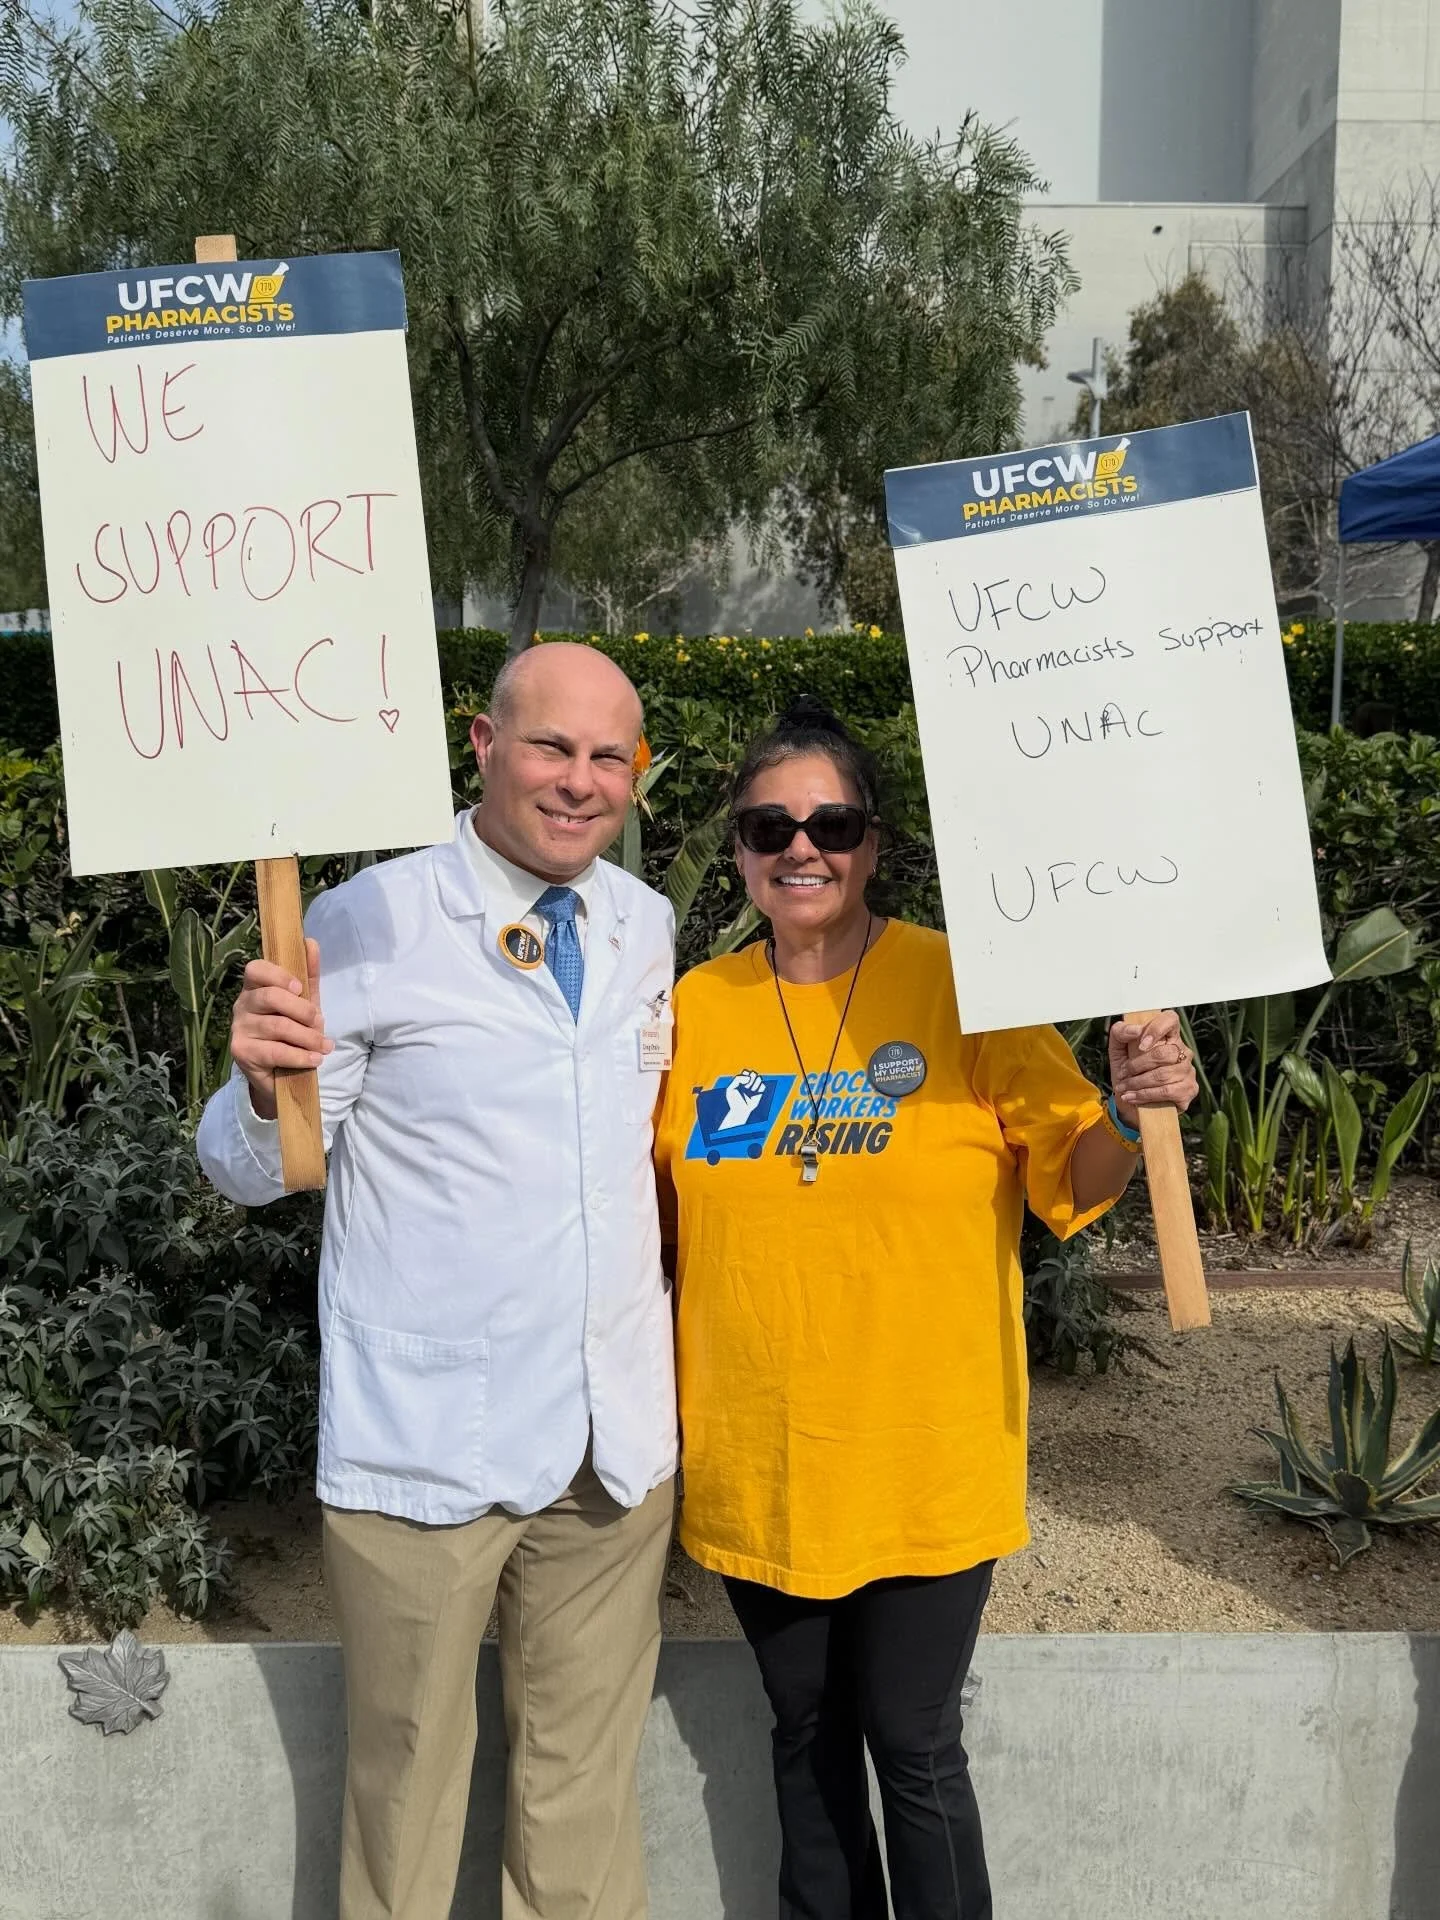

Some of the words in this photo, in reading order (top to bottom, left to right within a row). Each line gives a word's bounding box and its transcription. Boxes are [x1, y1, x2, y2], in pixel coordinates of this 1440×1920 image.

[118, 272, 253, 312] UFCW
[106, 303, 295, 334] PHARMACISTS
[107, 333, 151, 344] Patients
[155, 328, 199, 339] Deserve
[204, 326, 234, 335] More.
[239, 325, 252, 333] So
[257, 325, 271, 333] Do
[276, 323, 296, 332] We!
[83, 363, 204, 464] WE
[972, 451, 1097, 498] UFCW
[962, 475, 1138, 521] PHARMACISTS
[965, 518, 1006, 530] Patients
[1010, 509, 1051, 522] Deserve
[1055, 503, 1083, 514] More.
[1087, 500, 1100, 509] So
[1104, 497, 1117, 506] Do
[1121, 494, 1140, 503] We!
[76, 493, 398, 603] SUPPORT
[948, 566, 1106, 632] UFCW
[947, 637, 1135, 688] Pharmacists
[1011, 702, 1163, 758] UNAC
[991, 855, 1178, 922] UFCW
[878, 1058, 920, 1070] SUPPORT
[889, 1066, 915, 1075] UFCW
[789, 1096, 898, 1120] WORKERS
